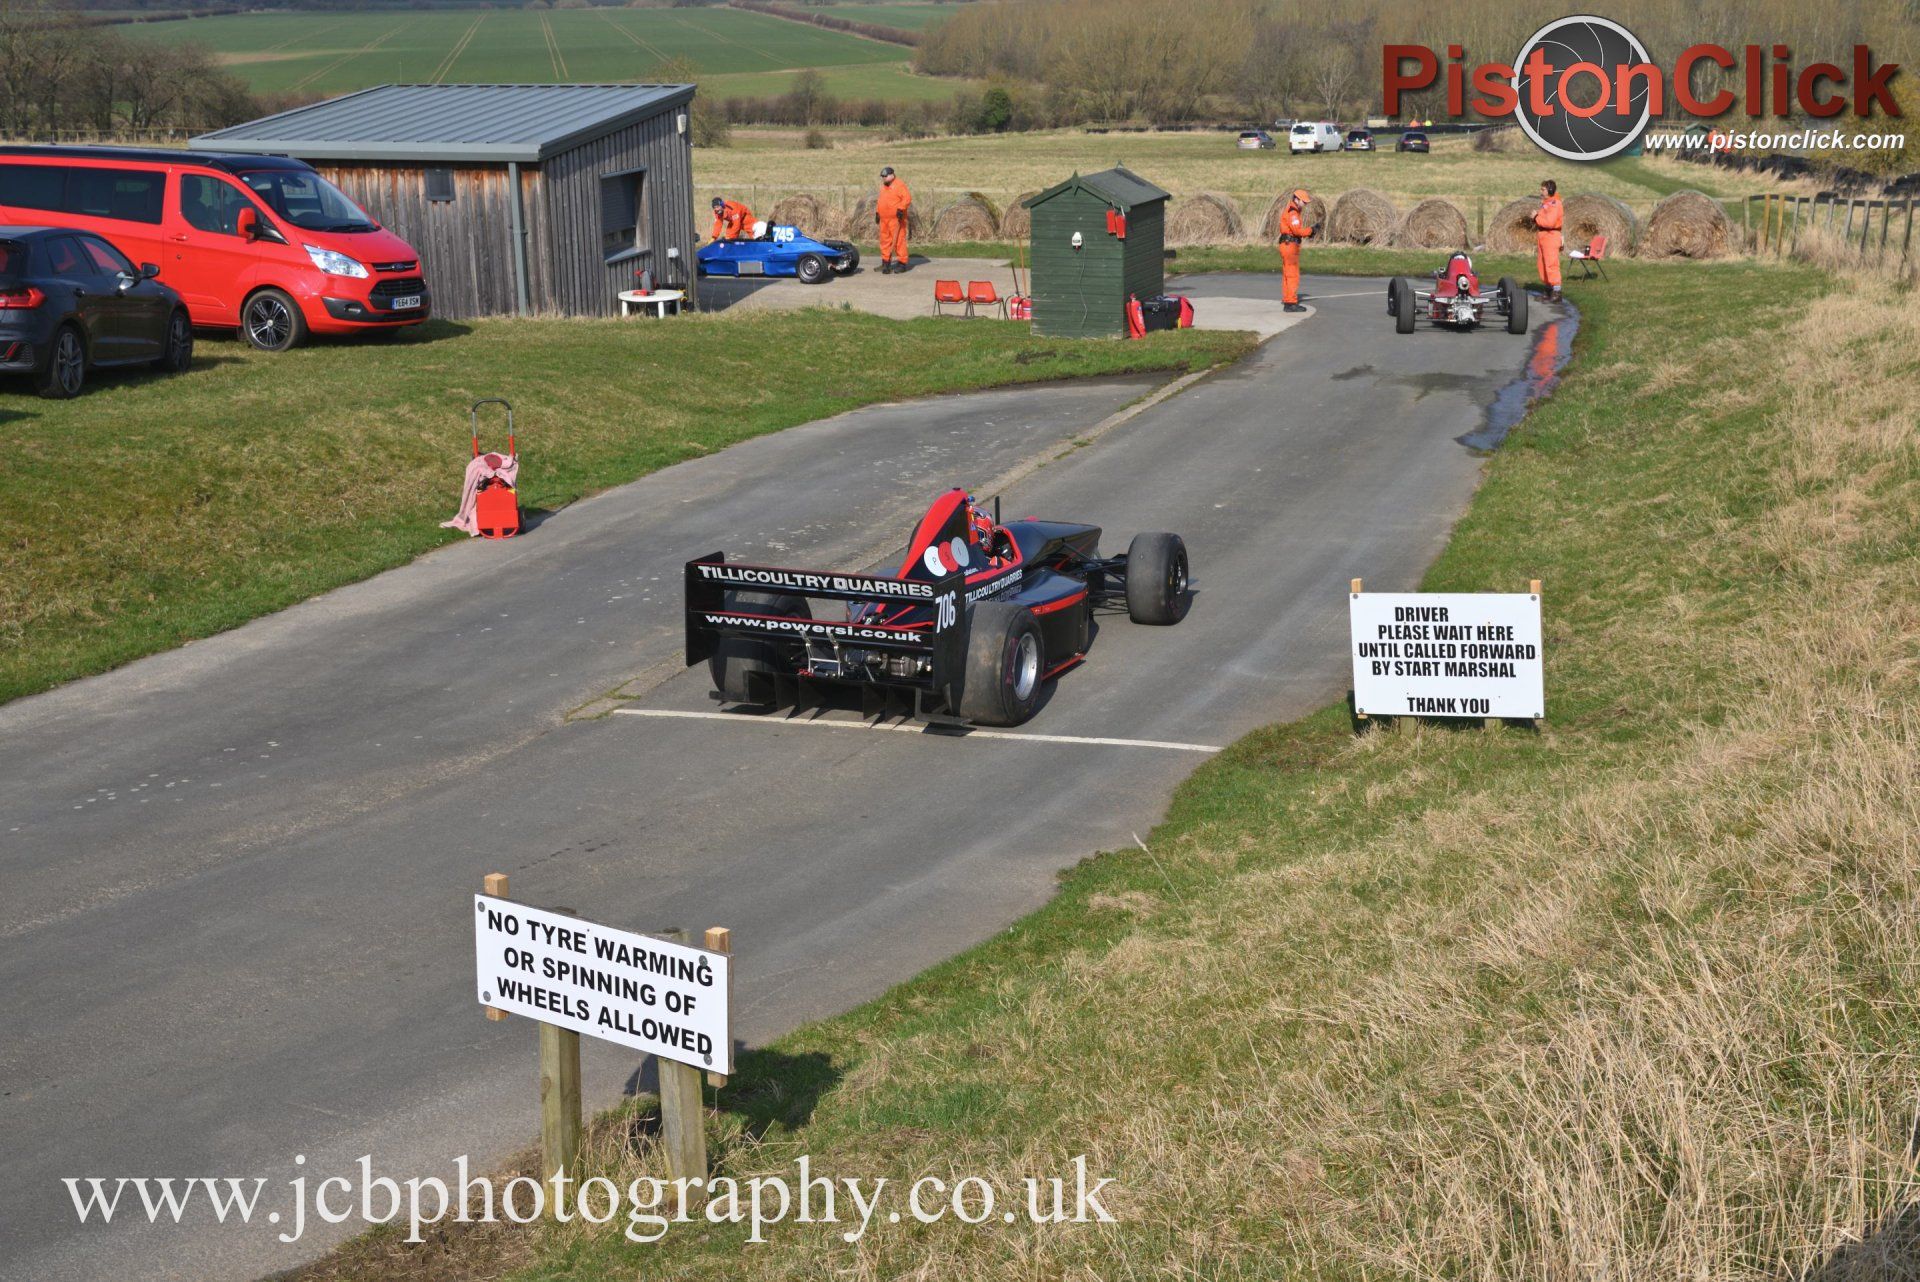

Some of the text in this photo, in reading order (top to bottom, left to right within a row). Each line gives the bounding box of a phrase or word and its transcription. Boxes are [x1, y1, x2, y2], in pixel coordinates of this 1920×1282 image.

[772, 226, 795, 243] 745
[698, 565, 934, 597] TILLICOULTRY QUARRIES
[964, 580, 1001, 604] TILLICOULTRY
[999, 569, 1023, 590] QUARRIES
[935, 590, 956, 633] 706
[1394, 606, 1449, 622] DRIVER
[705, 615, 922, 642] www.powersi.co.uk
[1378, 625, 1514, 641] PLEASE WAIT HERE
[1358, 643, 1536, 660] UNTIL CALLED FORWARD
[1372, 661, 1516, 678] BY START MARSHAL
[1407, 697, 1490, 714] THANK YOU
[488, 909, 713, 987] NO TYRE WARMING
[504, 947, 697, 1016] OR SPINNING OF
[497, 976, 713, 1056] WHEELS ALLOWED
